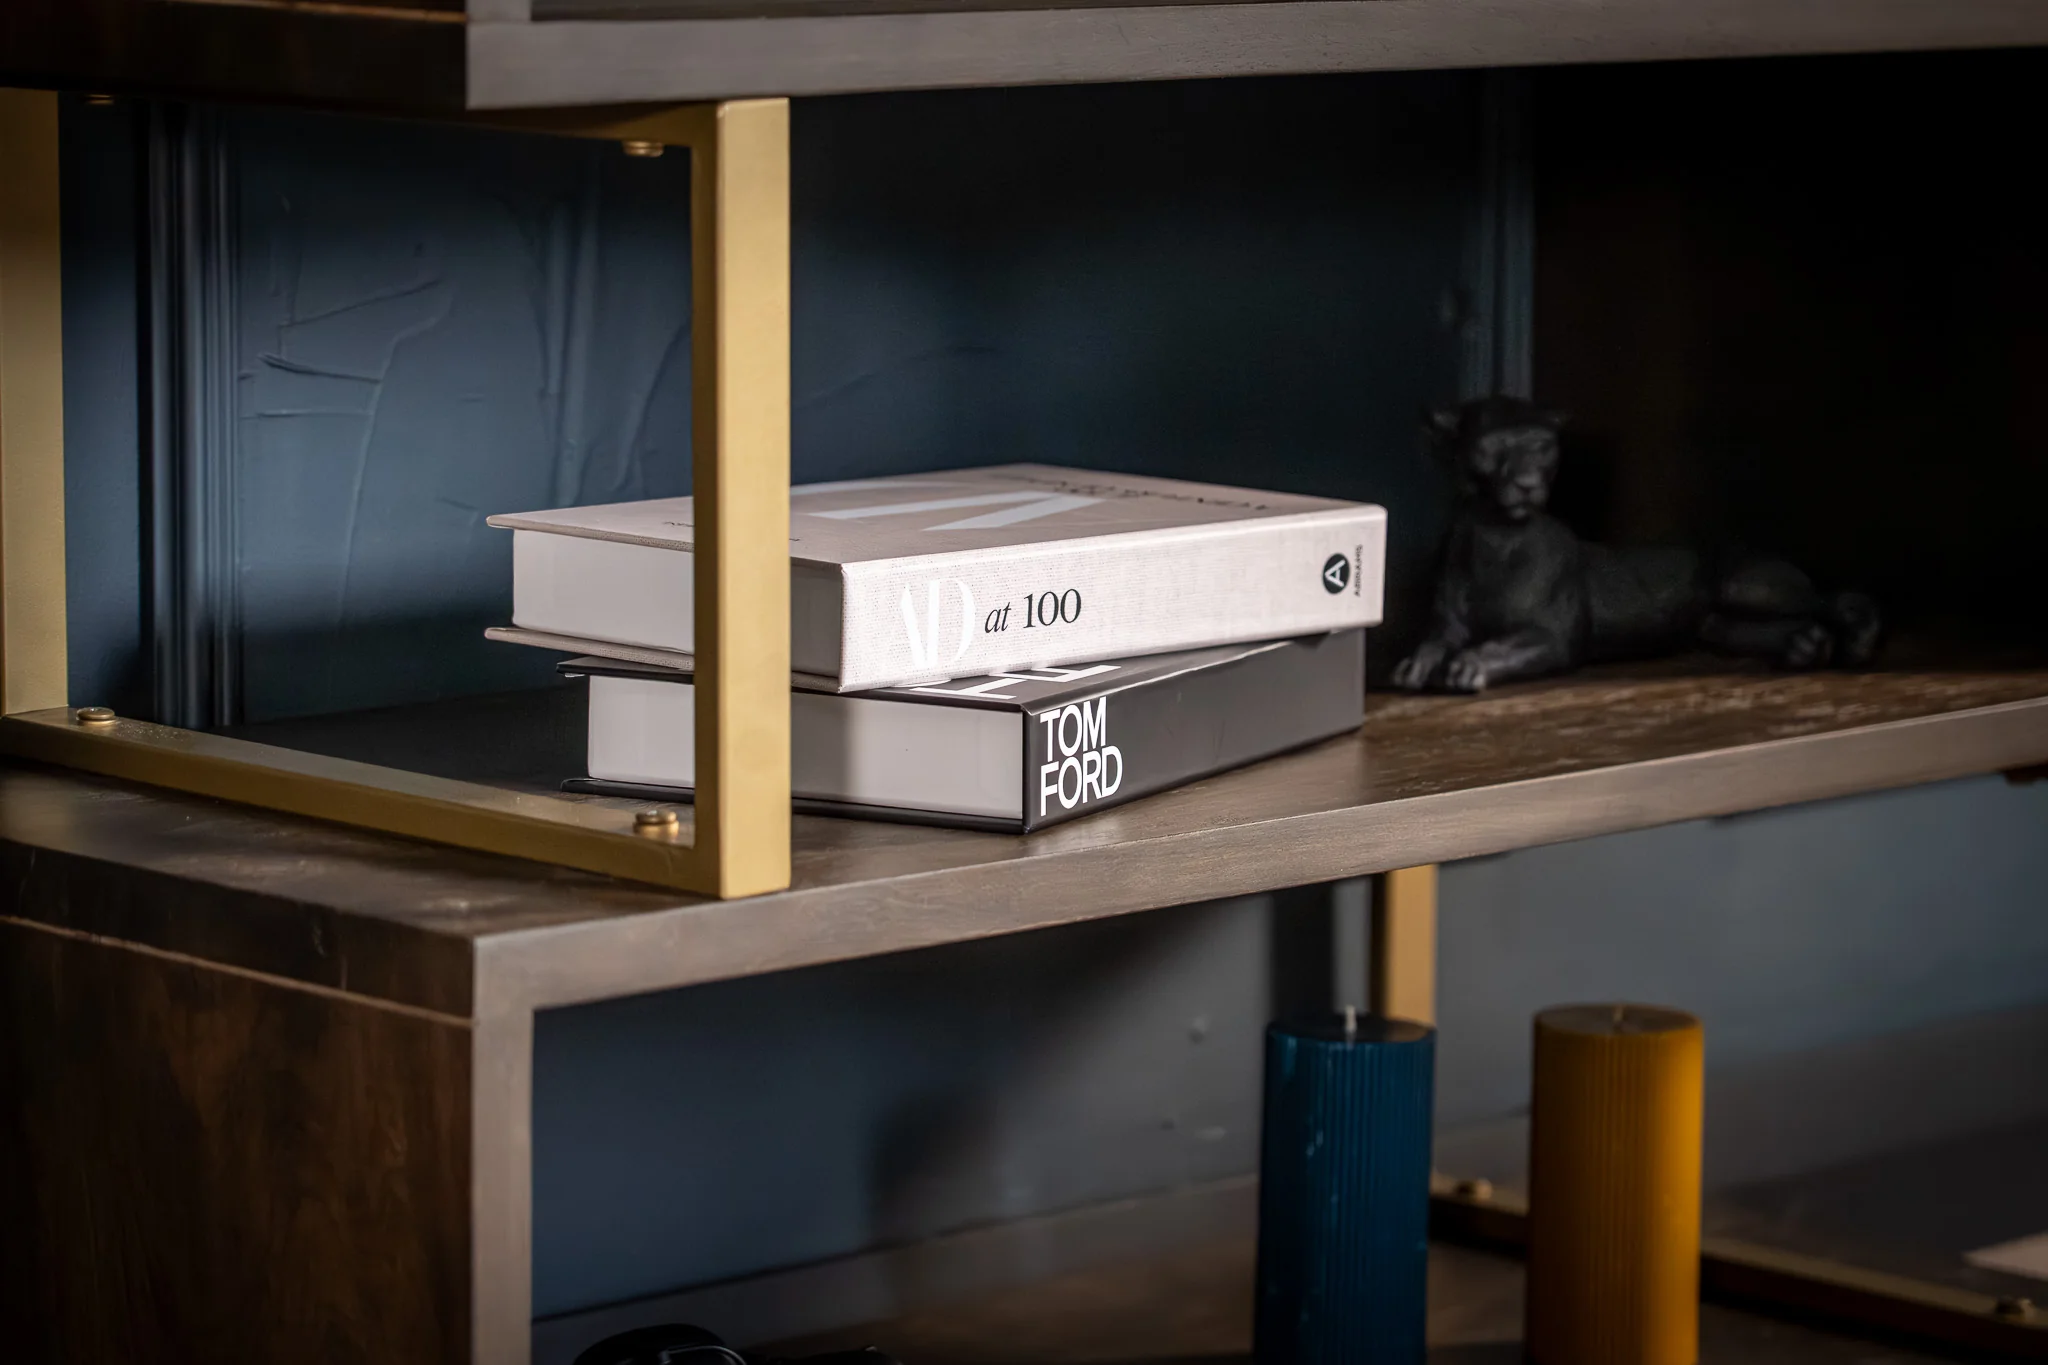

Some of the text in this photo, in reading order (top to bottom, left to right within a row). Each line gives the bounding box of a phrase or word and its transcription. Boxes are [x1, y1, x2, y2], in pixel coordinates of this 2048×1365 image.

[984, 602, 1011, 634] at
[1023, 588, 1082, 629] 100
[1040, 696, 1107, 763] TOM
[1040, 745, 1123, 817] FORD
